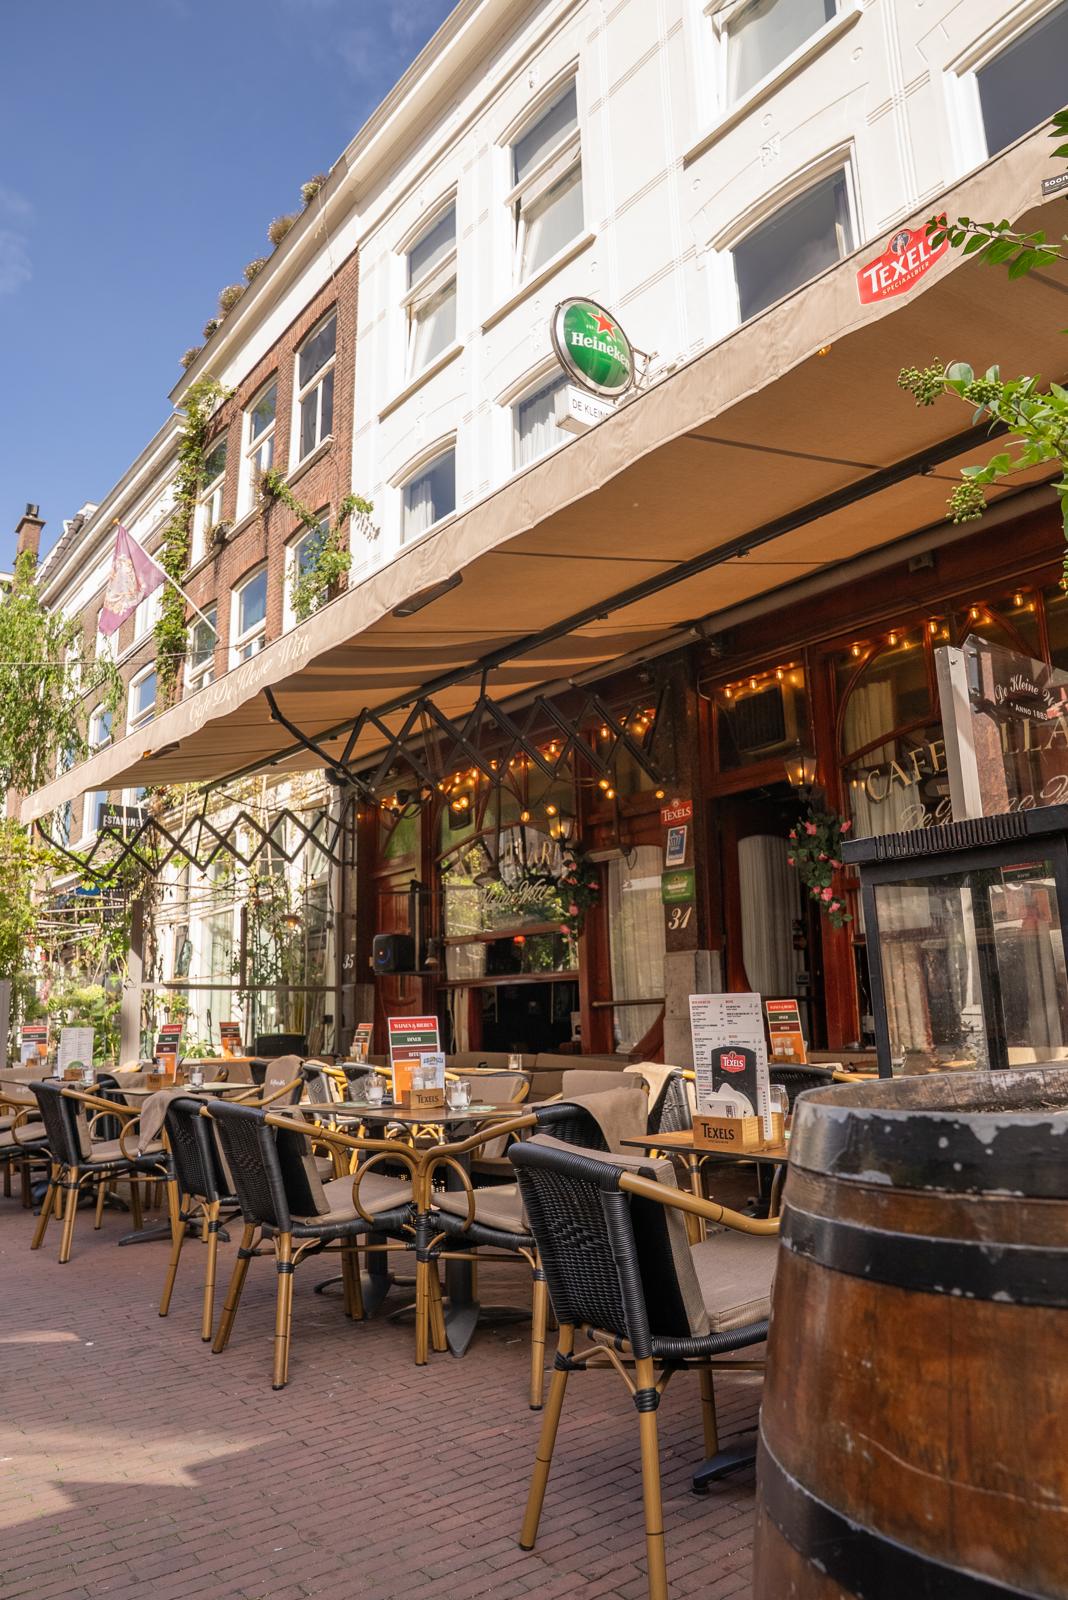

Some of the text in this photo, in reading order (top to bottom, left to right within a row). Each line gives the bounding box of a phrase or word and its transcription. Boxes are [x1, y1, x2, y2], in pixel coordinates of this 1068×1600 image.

[881, 261, 930, 296] SPECIAALBIER
[572, 399, 583, 412] DE
[1010, 674, 1039, 695] Kleine
[1015, 704, 1048, 721] ANNO 1883
[661, 806, 692, 822] TEXELS
[668, 906, 692, 930] 31
[722, 1056, 744, 1068] TEXELS
[416, 1094, 440, 1104] TEXELS
[701, 1123, 735, 1140] TEXELS
